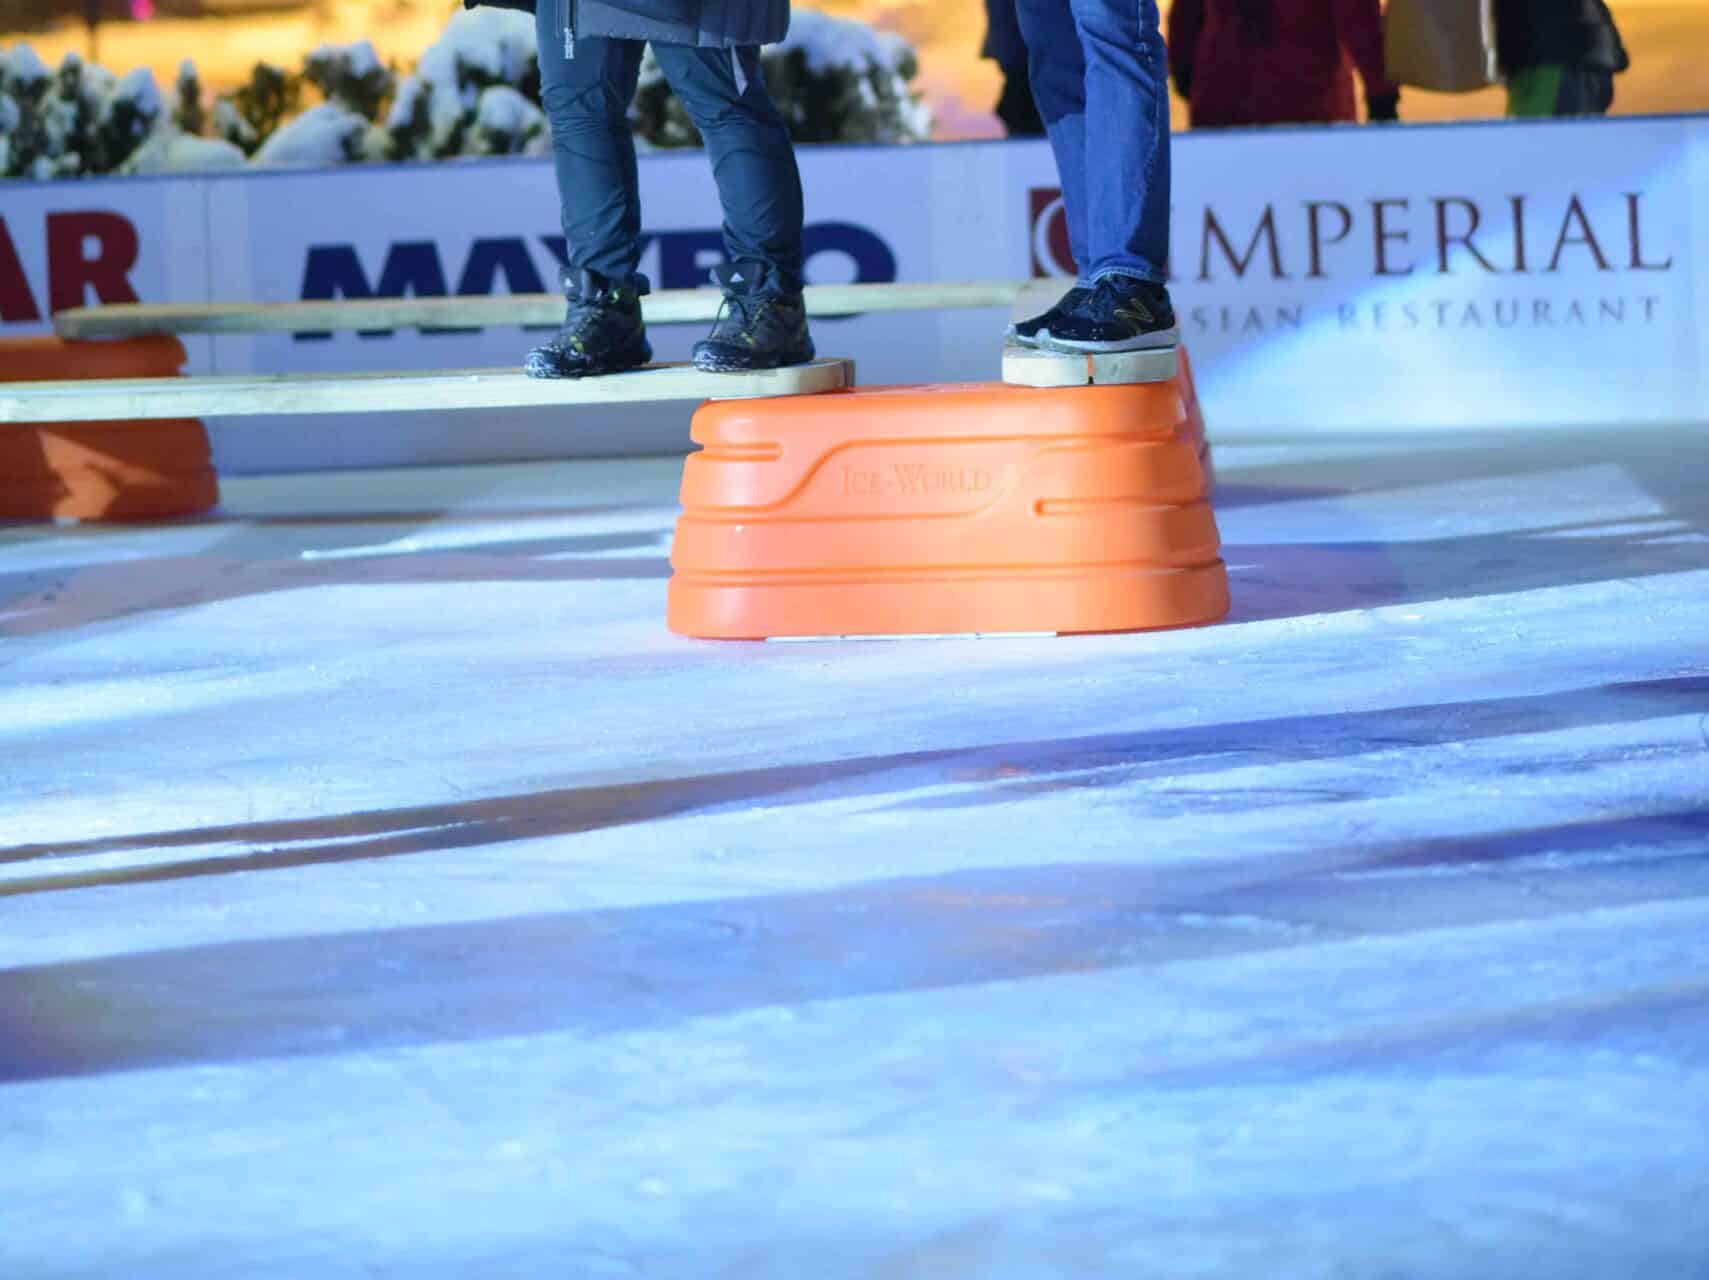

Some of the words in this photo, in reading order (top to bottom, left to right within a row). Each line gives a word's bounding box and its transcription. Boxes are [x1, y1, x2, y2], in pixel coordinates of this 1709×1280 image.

[1166, 190, 1673, 282] MPERIAL
[1189, 305, 1304, 332] SIAN
[1337, 294, 1661, 329] RESTAURANT
